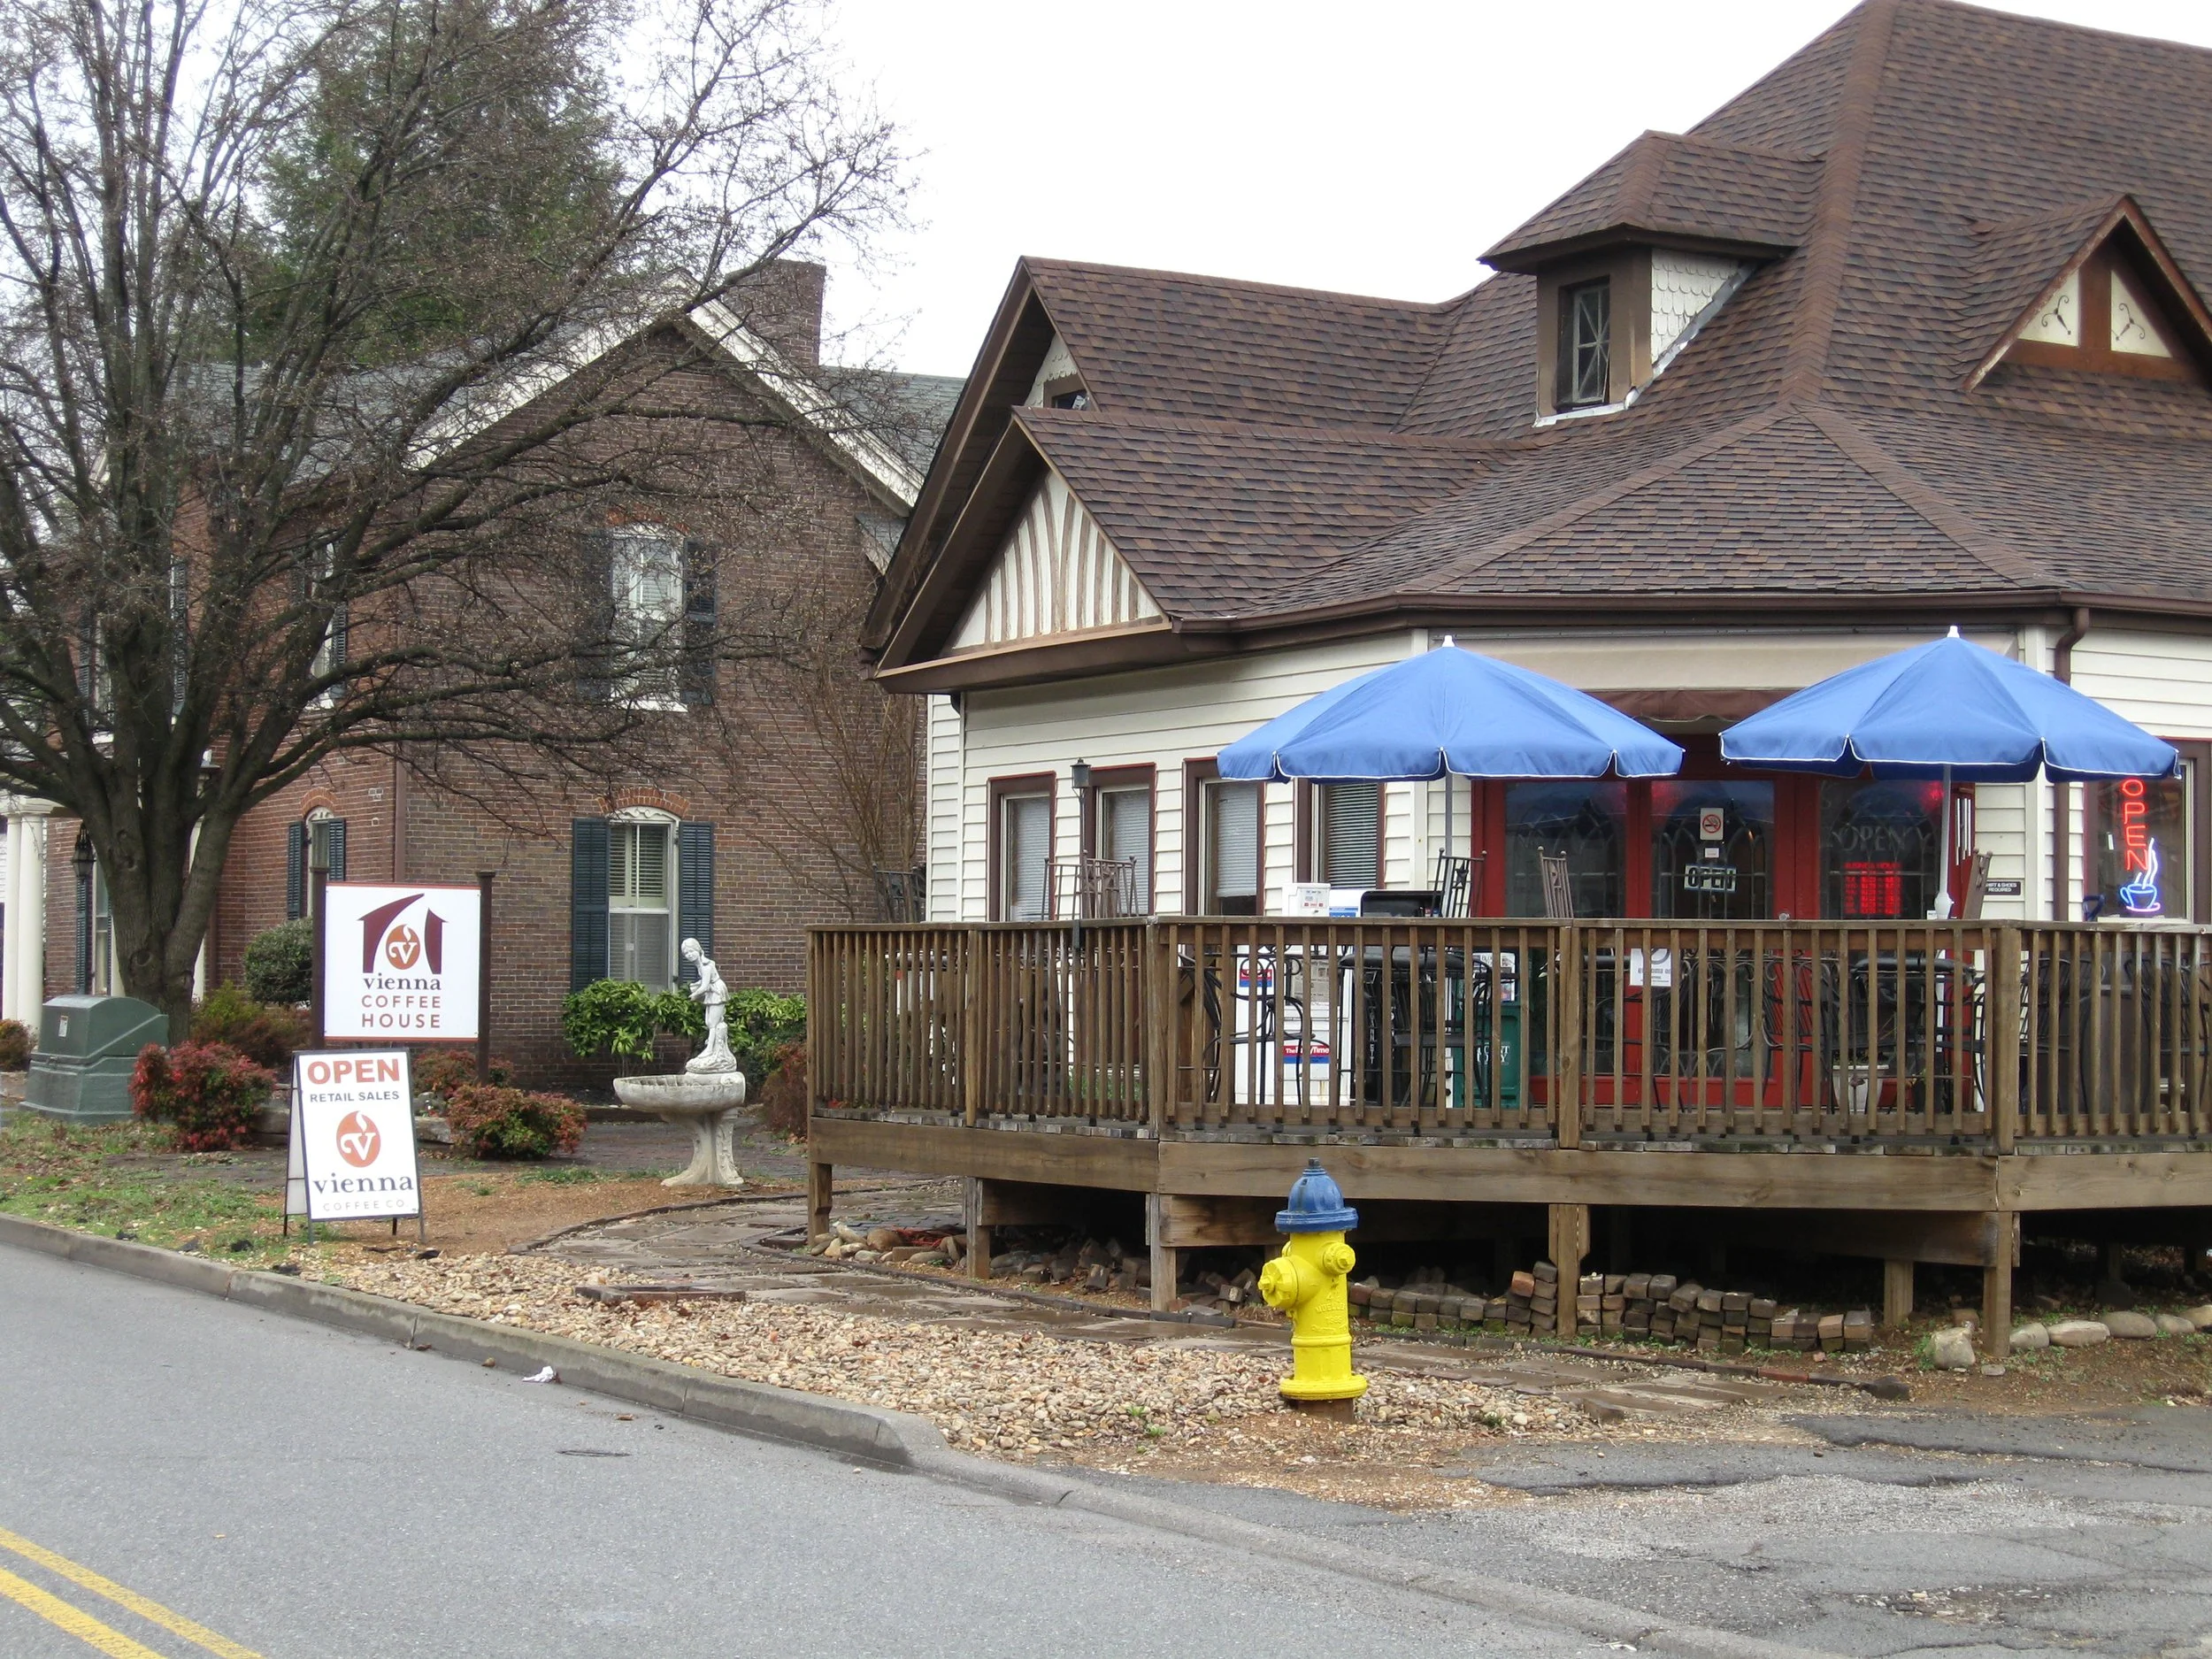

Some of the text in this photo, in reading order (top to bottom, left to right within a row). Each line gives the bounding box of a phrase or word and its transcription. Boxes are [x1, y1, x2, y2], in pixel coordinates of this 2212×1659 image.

[2121, 778, 2148, 871] OPEN
[1687, 867, 1733, 889] OPEN
[363, 972, 442, 990] vienna
[361, 995, 441, 1009] COFFEE
[361, 1013, 441, 1028] HOUSE
[307, 1059, 400, 1085] OPEN
[310, 1091, 400, 1102] RETAIL SALES
[313, 1172, 413, 1194] vienna
[323, 1201, 380, 1212] COFFEE
